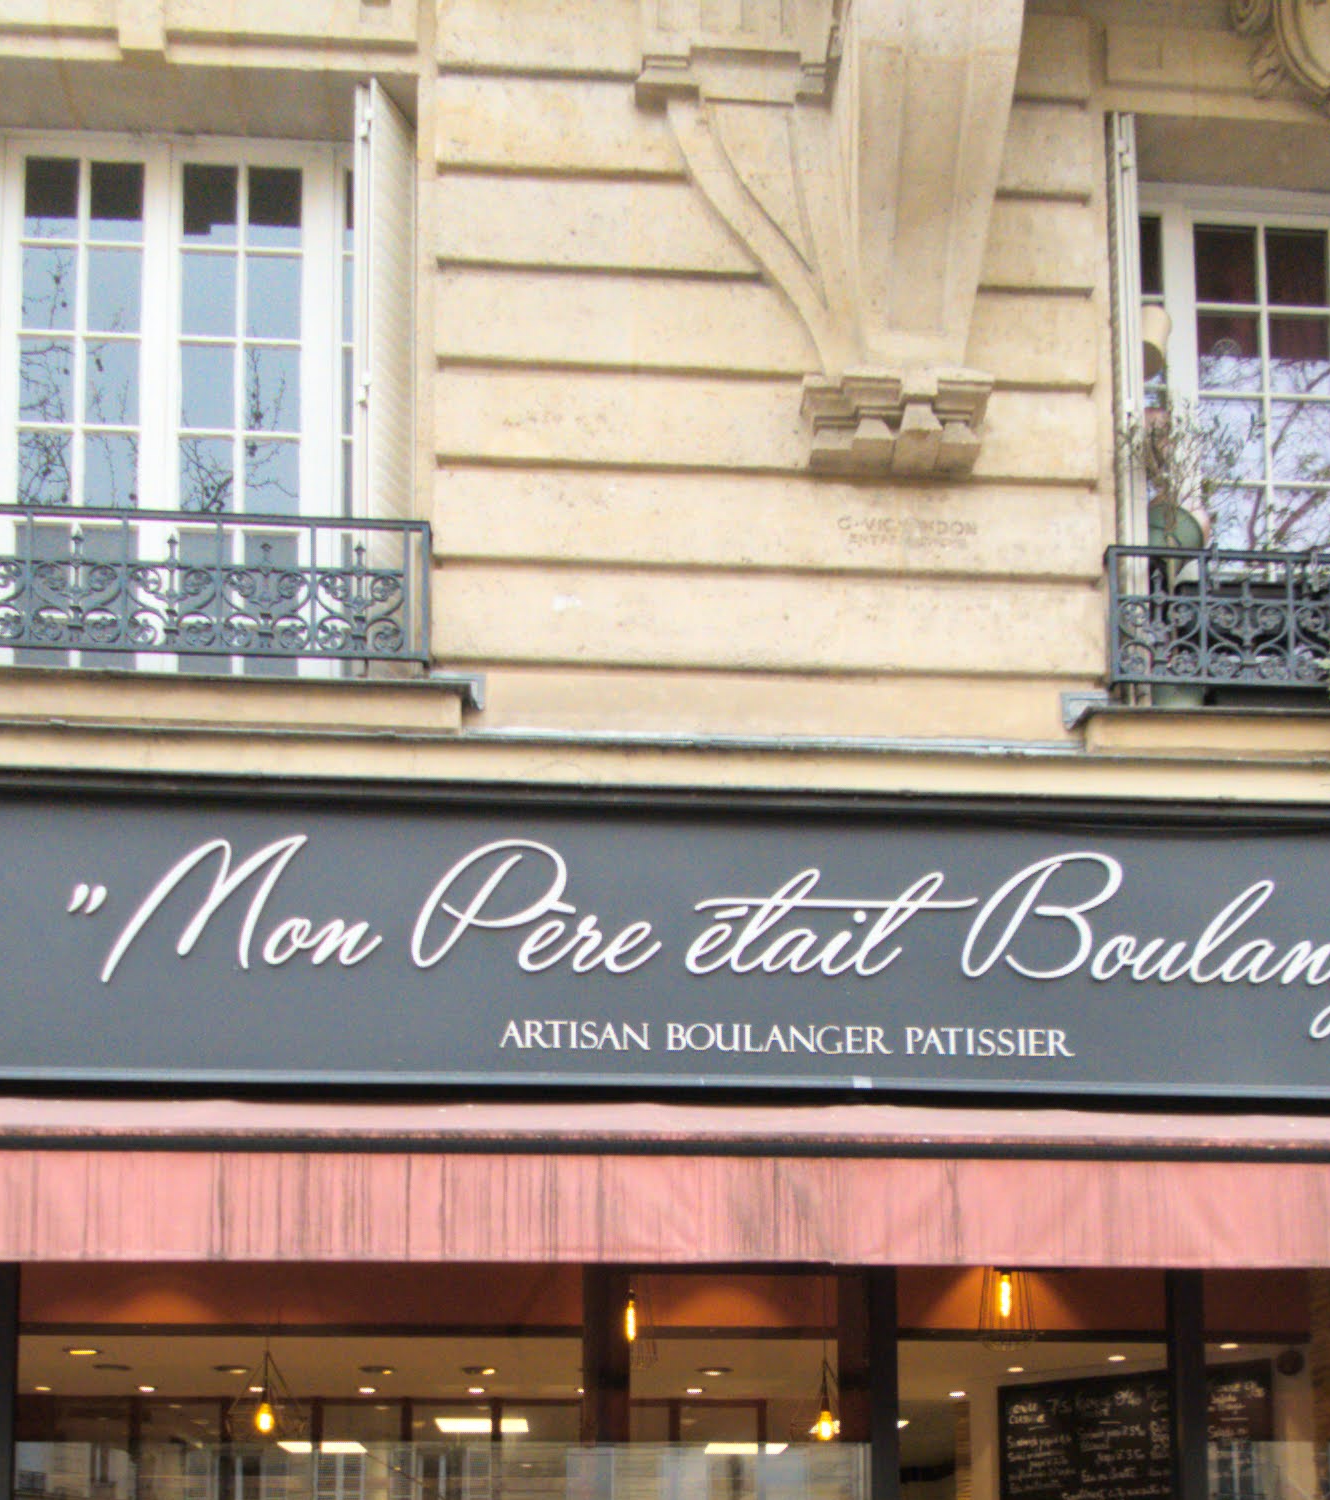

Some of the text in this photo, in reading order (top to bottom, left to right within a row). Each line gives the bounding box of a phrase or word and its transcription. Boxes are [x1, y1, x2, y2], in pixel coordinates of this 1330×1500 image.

[410, 838, 663, 974] Père
[684, 868, 979, 976] était
[499, 1019, 1076, 1058] ARTISAN BOULANGER PATISSIER
